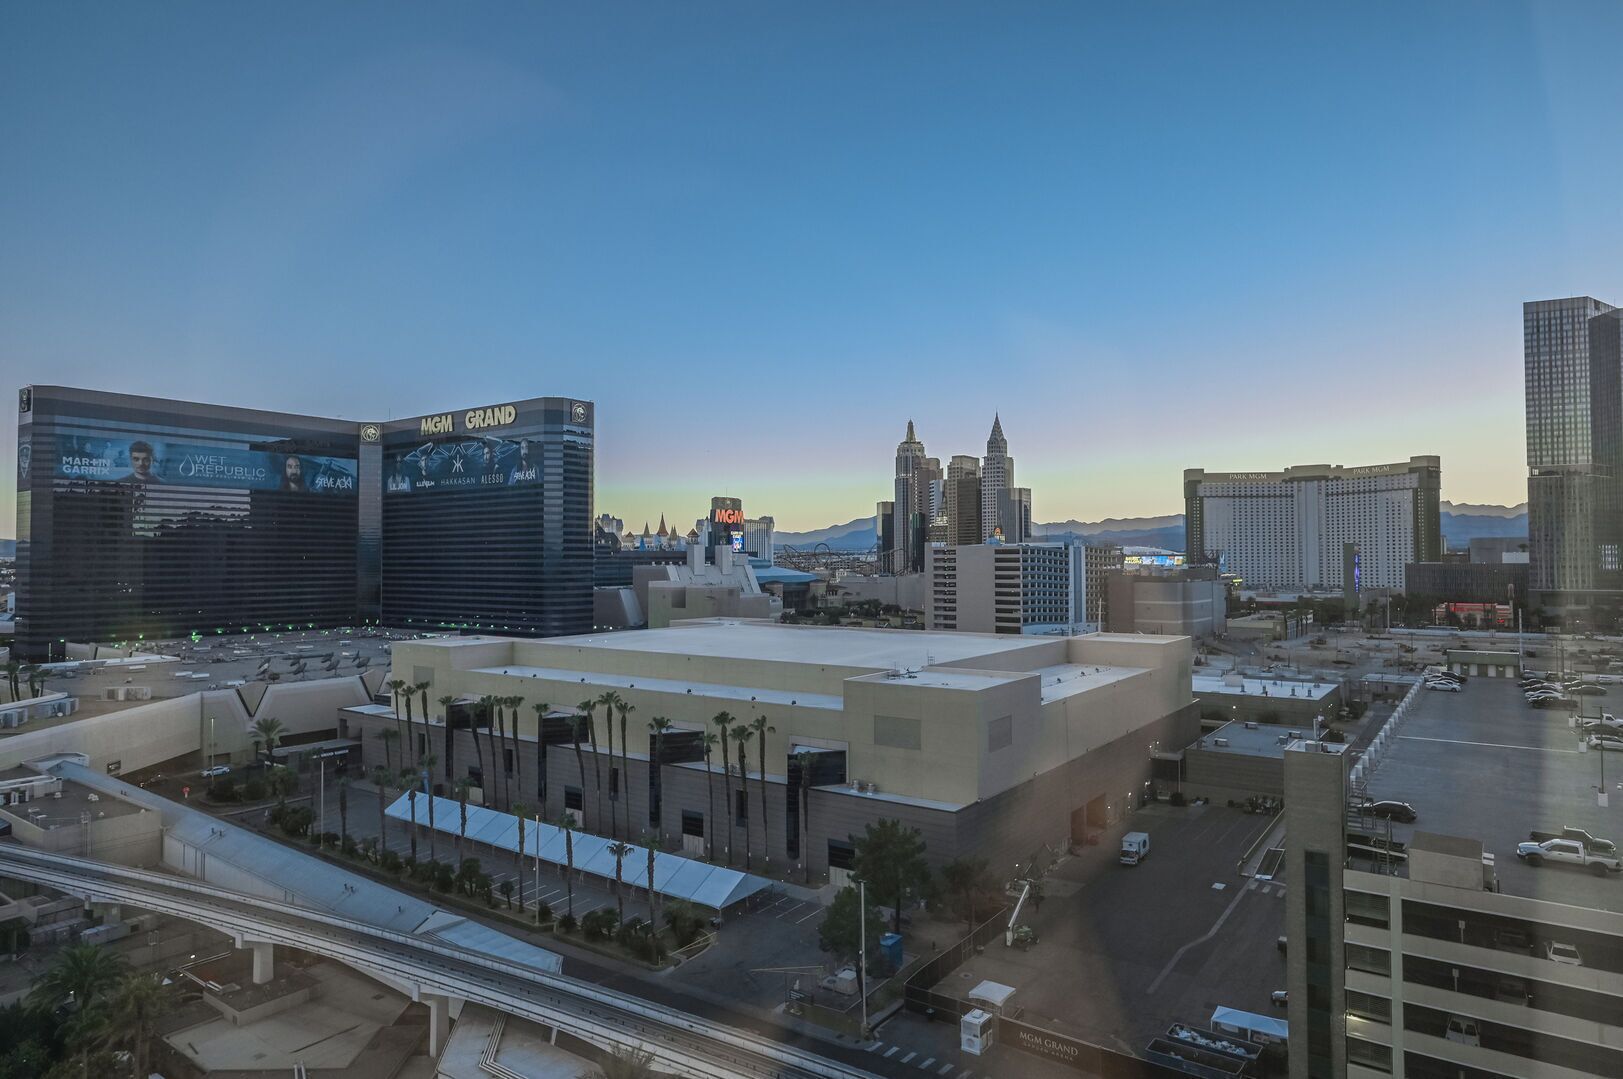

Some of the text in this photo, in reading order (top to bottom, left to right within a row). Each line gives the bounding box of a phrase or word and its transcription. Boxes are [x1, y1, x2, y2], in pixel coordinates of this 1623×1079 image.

[421, 406, 516, 435] MGM GRAND
[194, 454, 227, 465] WET
[62, 465, 111, 476] GARRIX
[195, 463, 267, 478] REPUBLIC
[1353, 465, 1390, 475] PARK MGM
[440, 477, 476, 486] HAKKASAN
[480, 473, 504, 484] ALESSO
[714, 509, 744, 524] MGM
[1019, 1031, 1079, 1056] MGM GRAND
